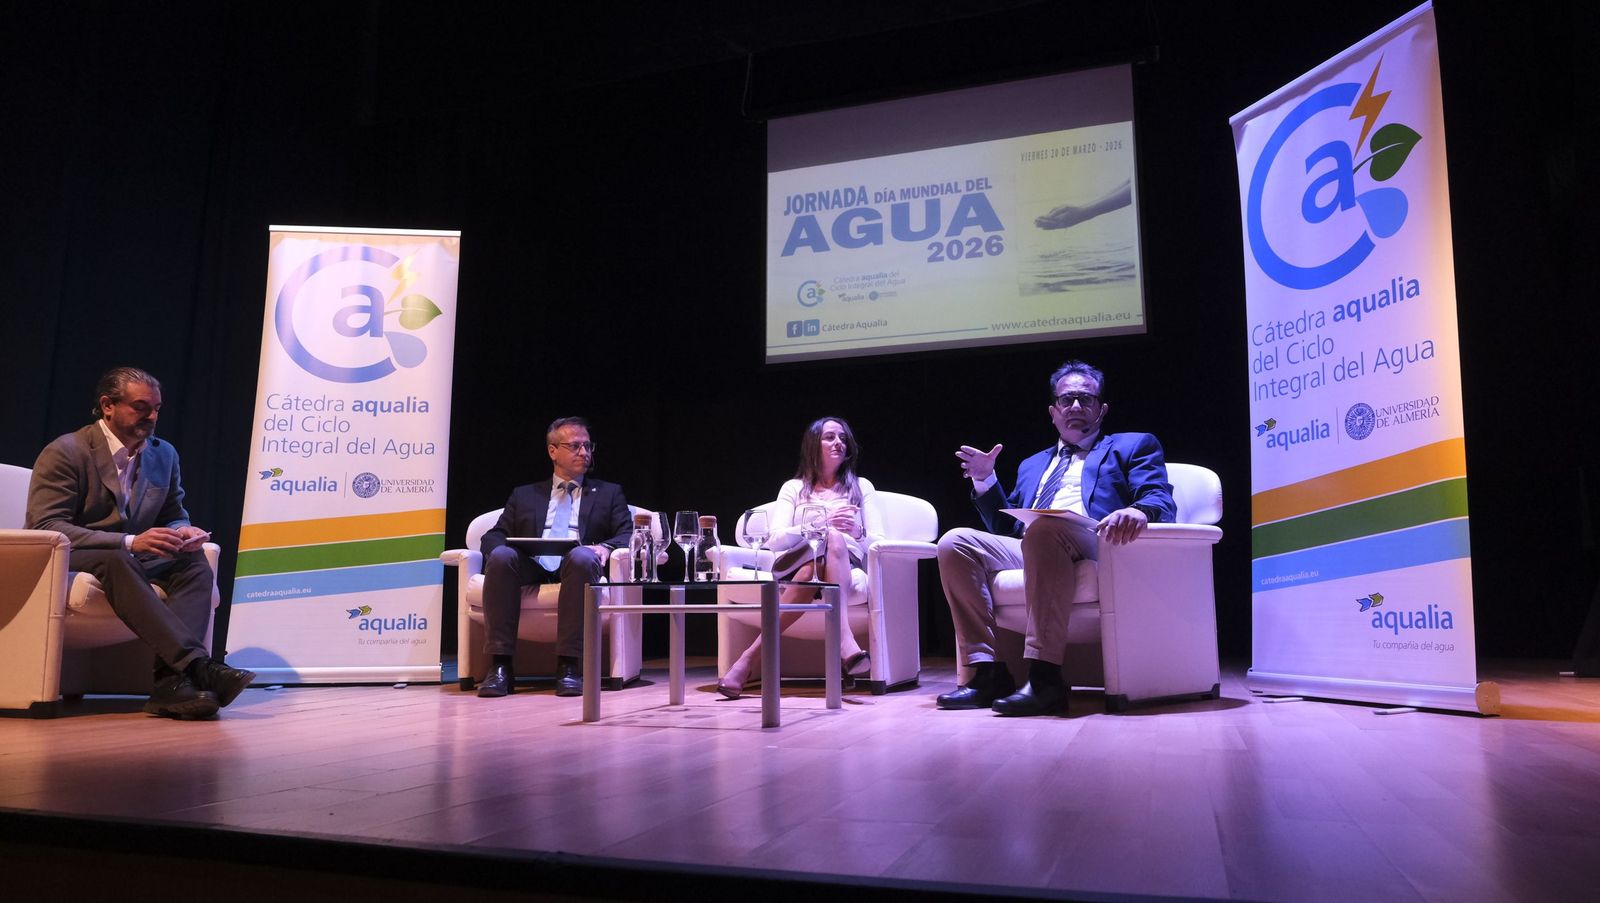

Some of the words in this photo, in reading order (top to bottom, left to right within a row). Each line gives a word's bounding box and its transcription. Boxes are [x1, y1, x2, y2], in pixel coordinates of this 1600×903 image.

[1020, 149, 1049, 161] VIERNES
[1061, 146, 1070, 157] DE
[1072, 143, 1097, 155] MARZO
[783, 186, 868, 216] JORNADA
[874, 187, 896, 204] DÍA
[900, 182, 962, 201] MUNDIAL
[966, 177, 992, 192] DEL
[780, 192, 1005, 257] AGUA
[927, 235, 1004, 263] 2026
[992, 311, 1131, 331] www.catedraaqualia.eu
[1252, 309, 1326, 347] Cátedra
[1333, 276, 1420, 322] aqualia
[822, 322, 855, 333] Cátedra
[856, 319, 888, 330] Aqualia
[1253, 347, 1279, 375] del
[1286, 334, 1334, 365] Ciclo
[1254, 362, 1326, 402] Integral
[1333, 352, 1365, 382] del
[1373, 339, 1435, 375] Agua
[266, 393, 345, 412] Cátedra
[351, 396, 430, 417] aqualia
[1375, 395, 1440, 418] UNIVERSIDAD
[264, 413, 294, 432] del
[301, 415, 351, 433] Ciclo
[1376, 416, 1390, 429] DE
[1392, 407, 1440, 426] ALMERÍA
[1266, 418, 1331, 451] aqualia
[262, 435, 340, 459] Integral
[346, 437, 376, 455] del
[382, 438, 436, 460] Agua
[270, 475, 338, 496] aqualia
[380, 479, 435, 487] UNIVERSIDAD
[380, 486, 393, 494] DE
[395, 485, 434, 494] ALMERÍA
[1260, 569, 1320, 586] catedraaqualia.eu
[246, 586, 312, 600] catedraaqualia.eu
[358, 613, 428, 636] aqualia
[1371, 603, 1454, 636] aqualia
[411, 638, 427, 646] agua
[1373, 640, 1381, 649] Tu
[1421, 641, 1434, 651] del
[1434, 644, 1455, 653] agua
